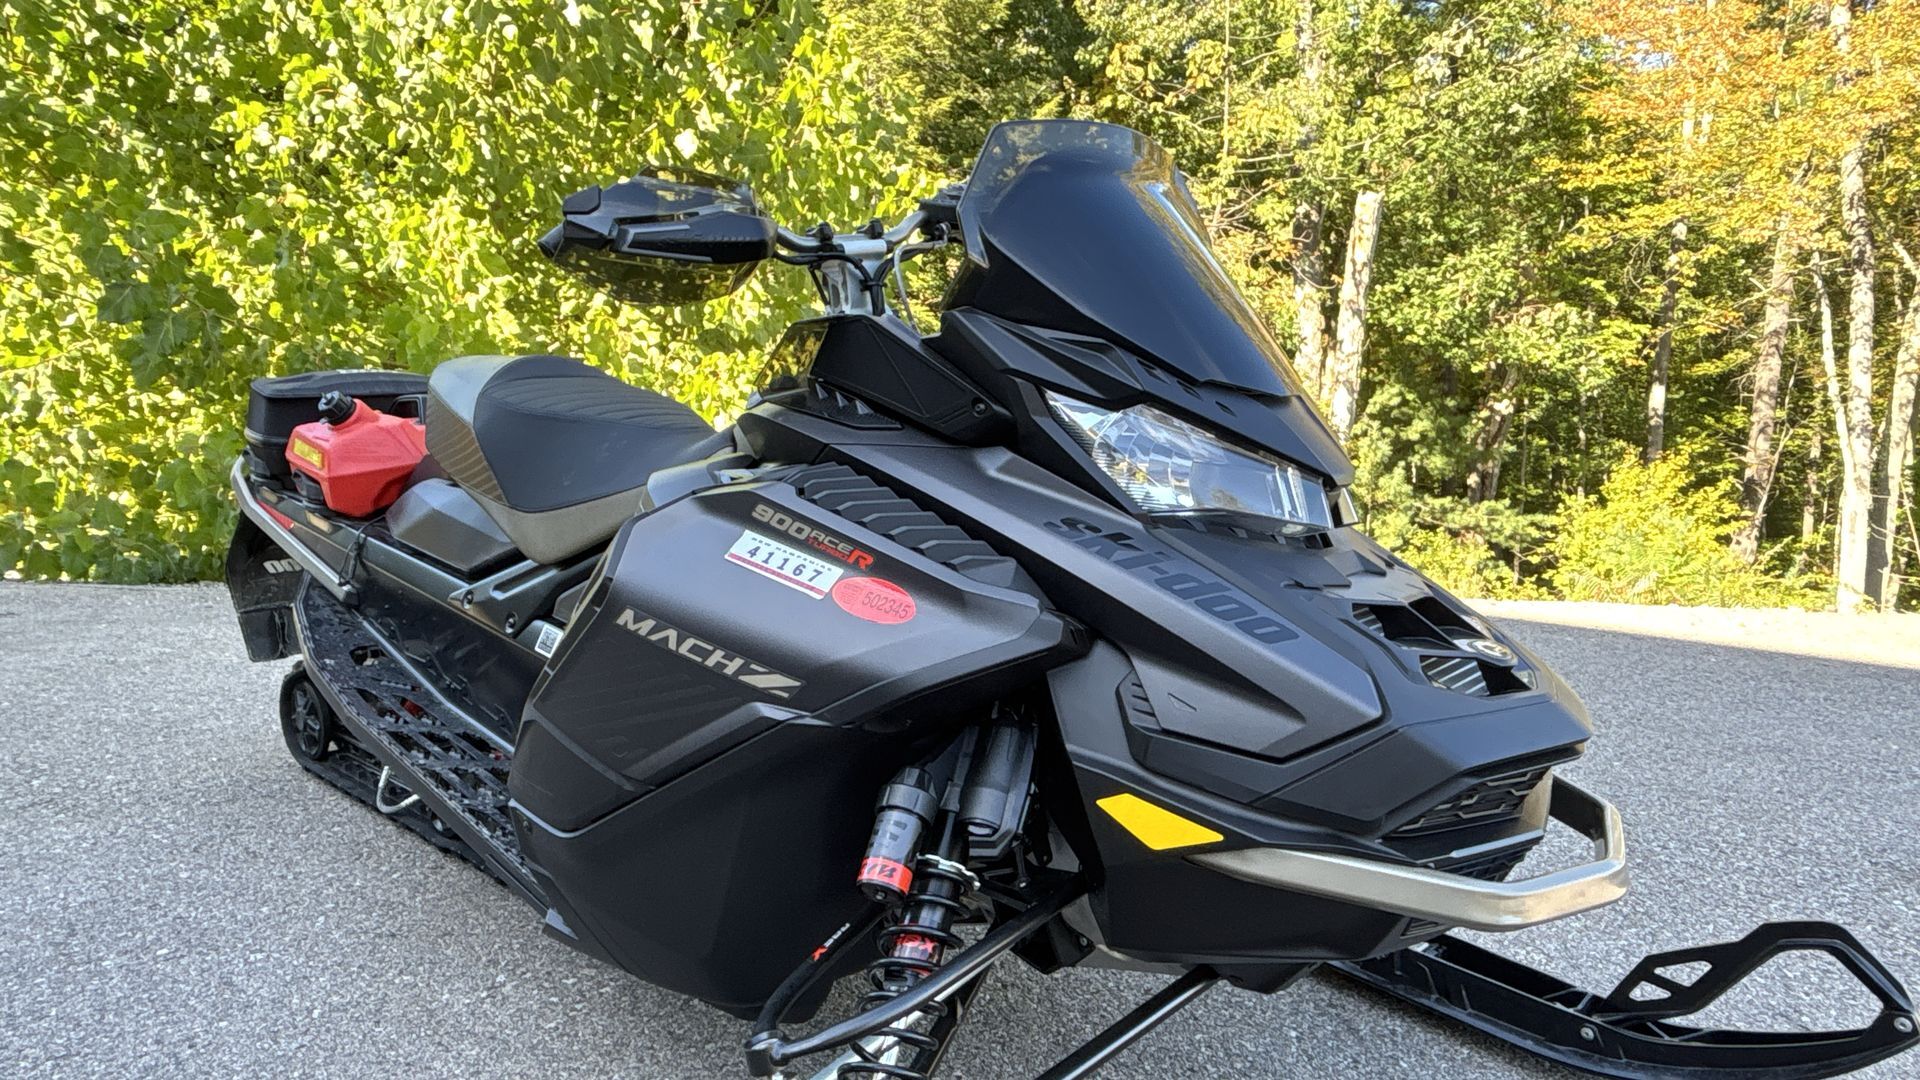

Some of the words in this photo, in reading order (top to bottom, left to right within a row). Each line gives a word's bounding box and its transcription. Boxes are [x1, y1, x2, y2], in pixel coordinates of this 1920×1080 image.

[751, 504, 811, 540] 900
[808, 530, 854, 555] ACE
[747, 545, 823, 582] 41167
